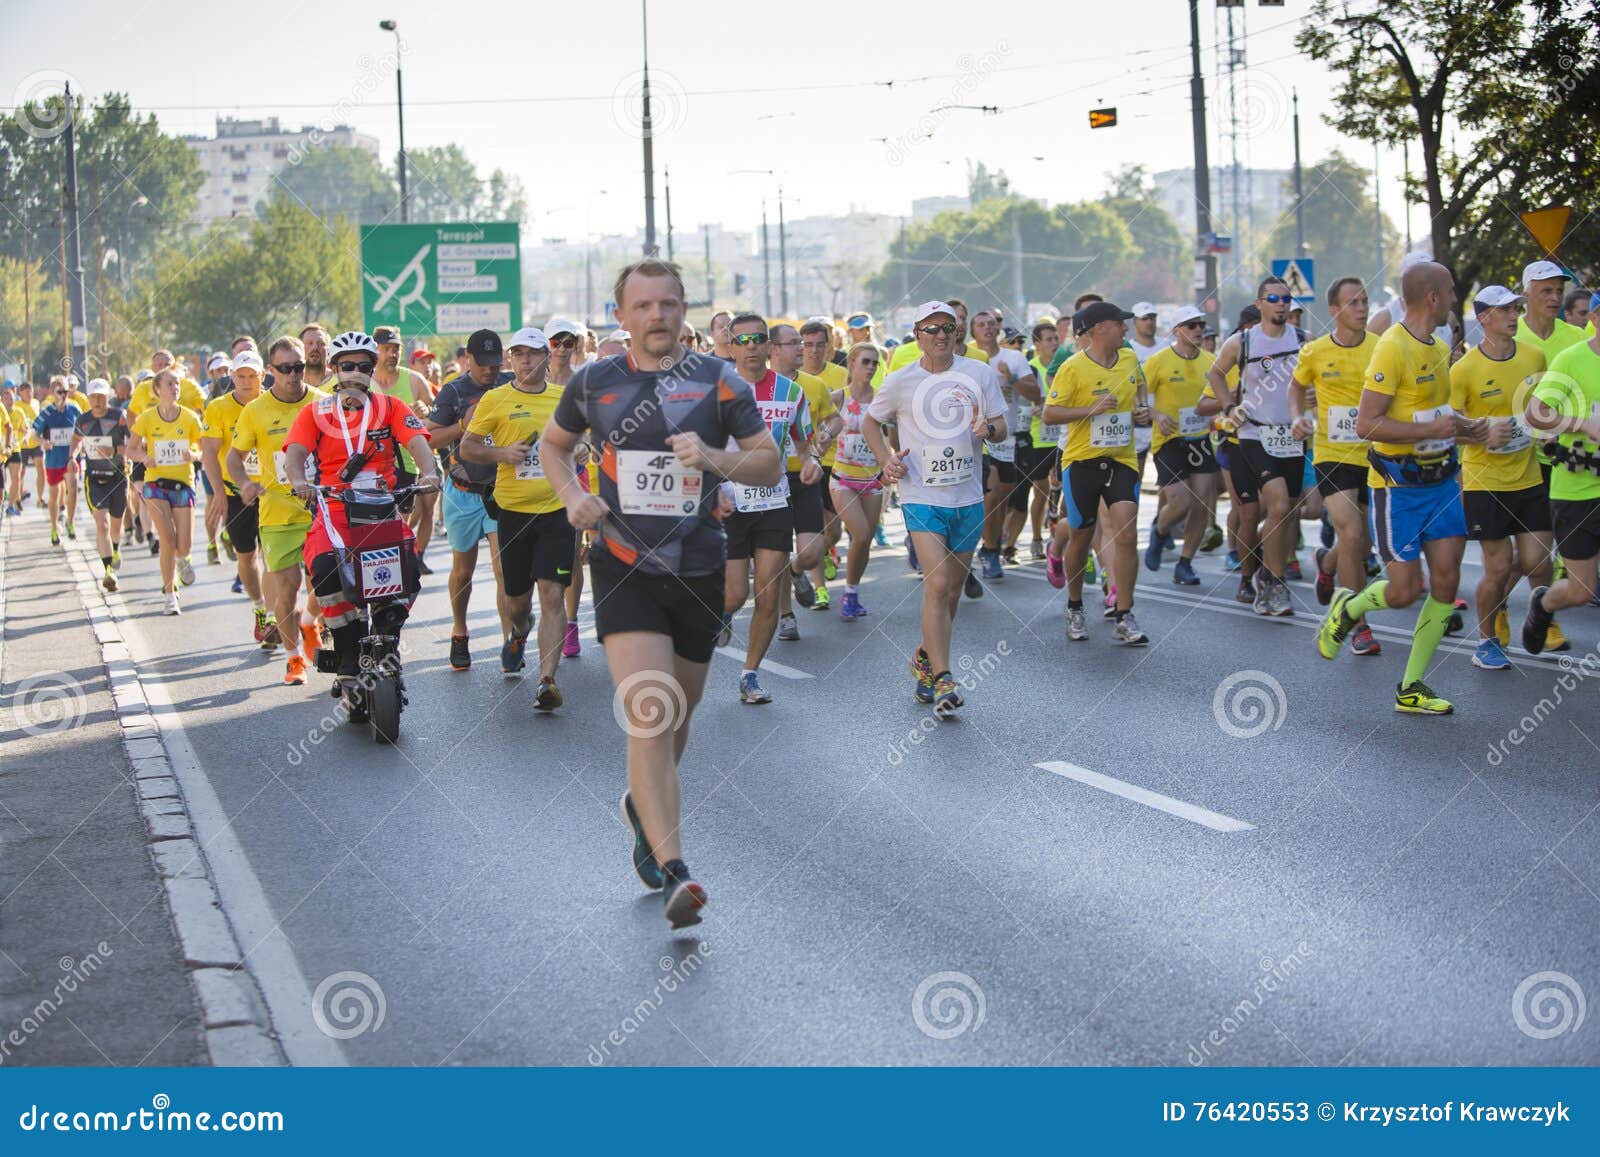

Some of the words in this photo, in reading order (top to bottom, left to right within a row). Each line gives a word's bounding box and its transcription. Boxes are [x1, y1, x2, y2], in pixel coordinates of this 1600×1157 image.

[1099, 424, 1125, 437] 1900
[647, 455, 676, 470] 4F
[931, 458, 964, 472] 2817
[636, 472, 674, 492] 970
[743, 486, 772, 500] 5780
